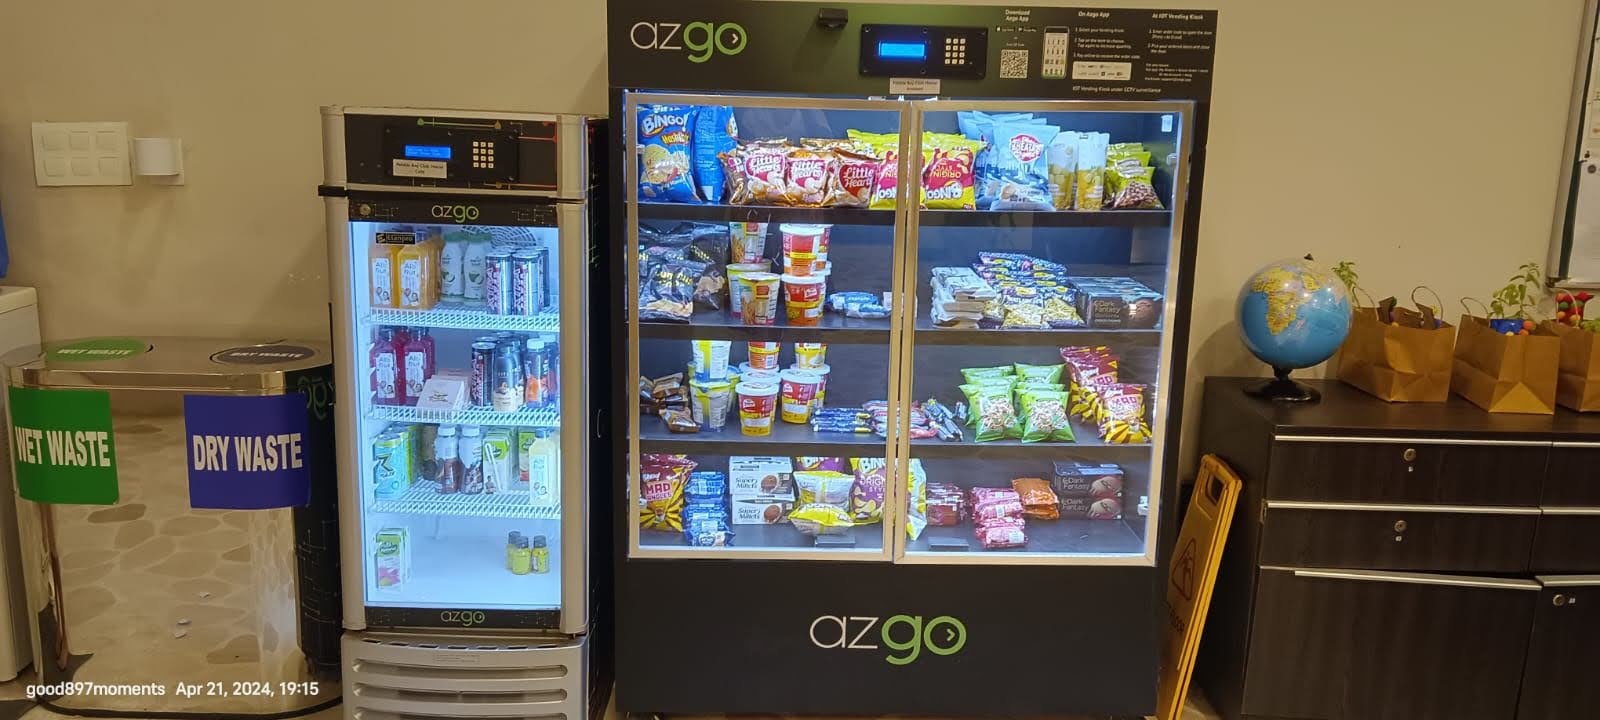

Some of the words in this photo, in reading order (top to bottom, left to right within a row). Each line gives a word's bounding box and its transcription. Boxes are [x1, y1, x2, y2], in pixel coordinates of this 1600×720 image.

[630, 21, 748, 63] azgo
[844, 167, 875, 182] Little
[431, 204, 480, 223] azgo
[14, 425, 43, 465] WET
[46, 428, 111, 468] WASTE
[191, 434, 231, 472] DRY
[234, 432, 304, 472] WASTE
[646, 483, 671, 495] MAD
[440, 611, 486, 627] azgo
[809, 614, 967, 665] azgo
